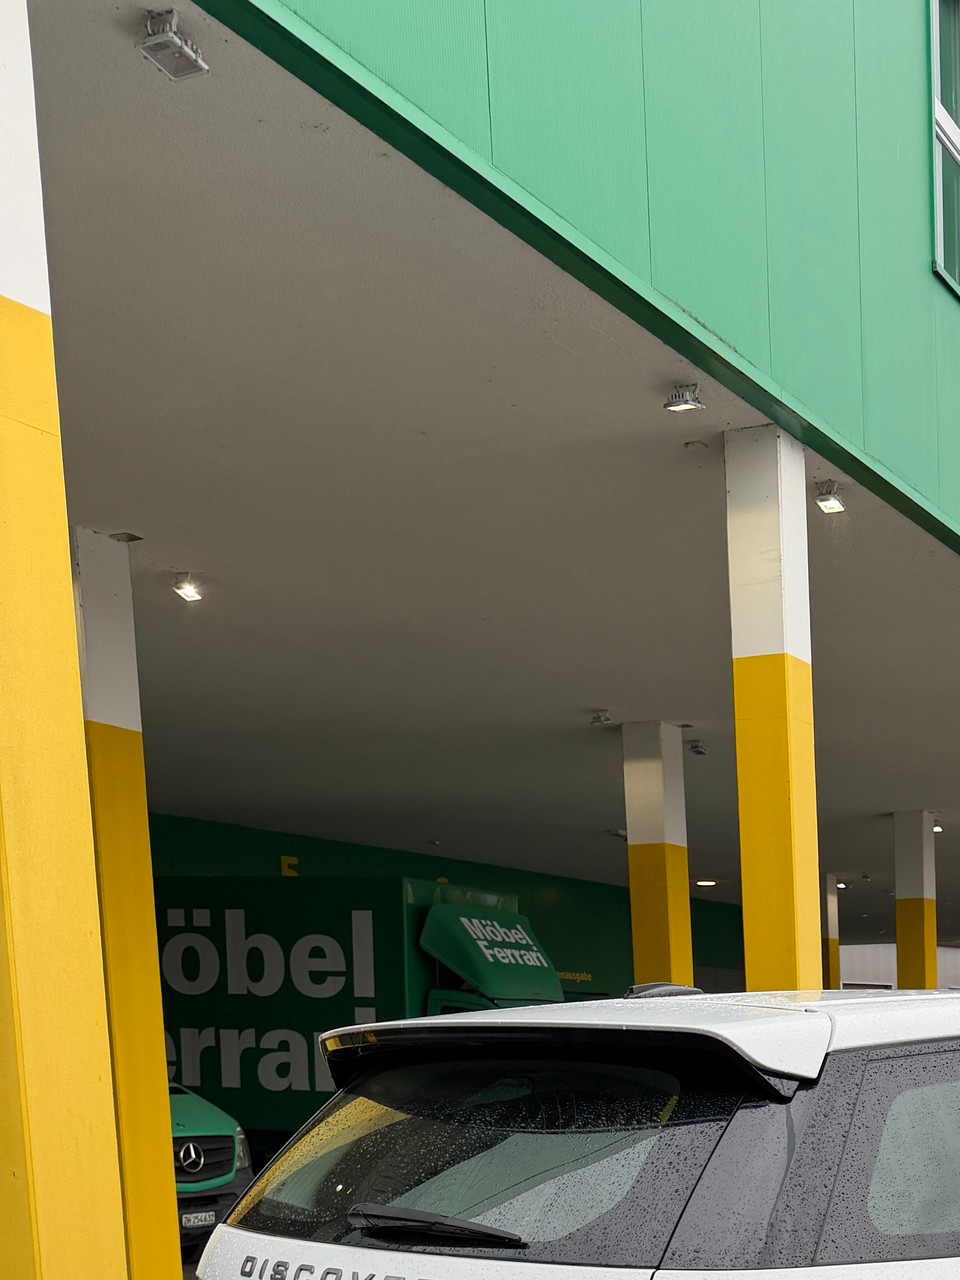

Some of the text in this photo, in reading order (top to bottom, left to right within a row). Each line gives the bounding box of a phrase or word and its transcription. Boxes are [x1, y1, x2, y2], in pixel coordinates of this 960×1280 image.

[459, 916, 534, 946] Möbel
[162, 909, 376, 998] öbel
[476, 940, 549, 969] Ferrari
